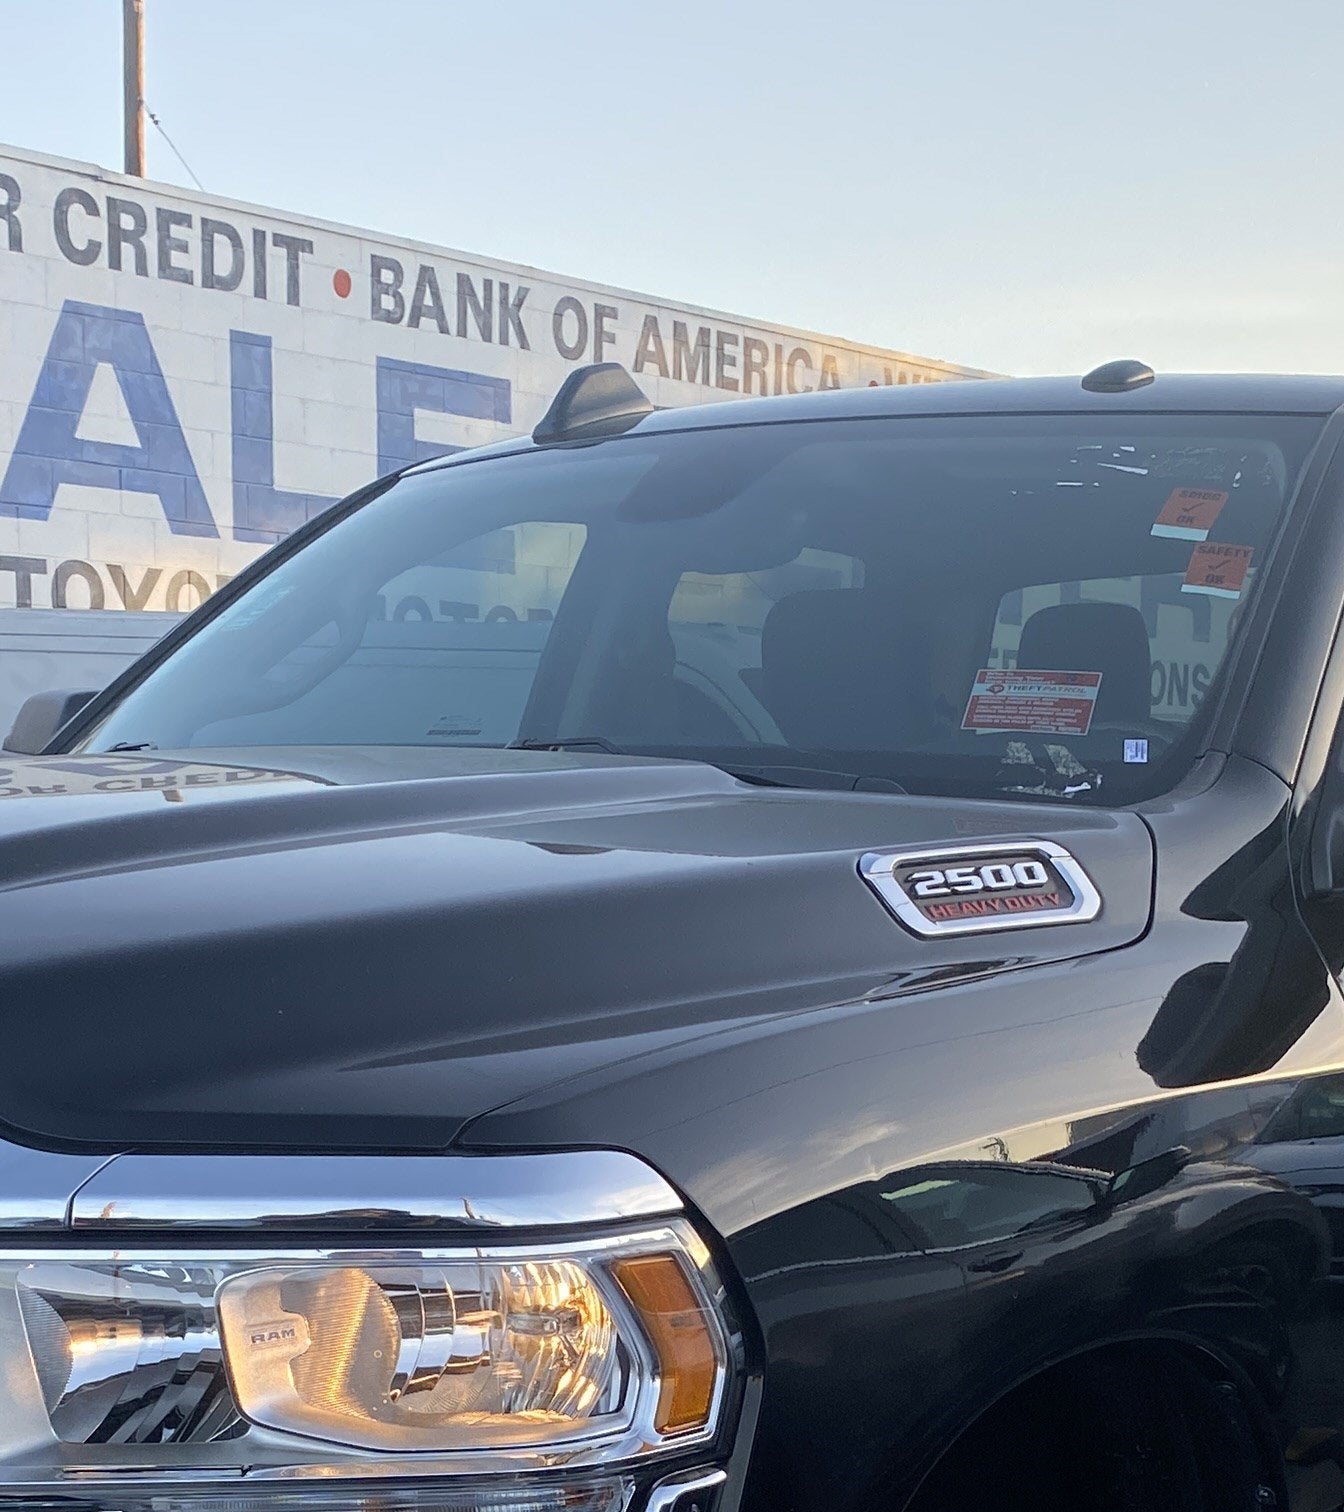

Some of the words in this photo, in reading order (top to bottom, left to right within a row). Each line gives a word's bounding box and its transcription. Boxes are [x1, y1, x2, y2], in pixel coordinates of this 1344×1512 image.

[54, 188, 315, 306] CREDIT
[370, 253, 531, 350] BANK
[553, 295, 618, 363] OF
[632, 314, 842, 397] AMERICA
[1197, 545, 1251, 558] SAFETY
[906, 861, 1049, 897] 2500
[927, 897, 1001, 919] HEAVY
[1004, 893, 1060, 911] DUTY
[251, 1328, 295, 1343] RAM
